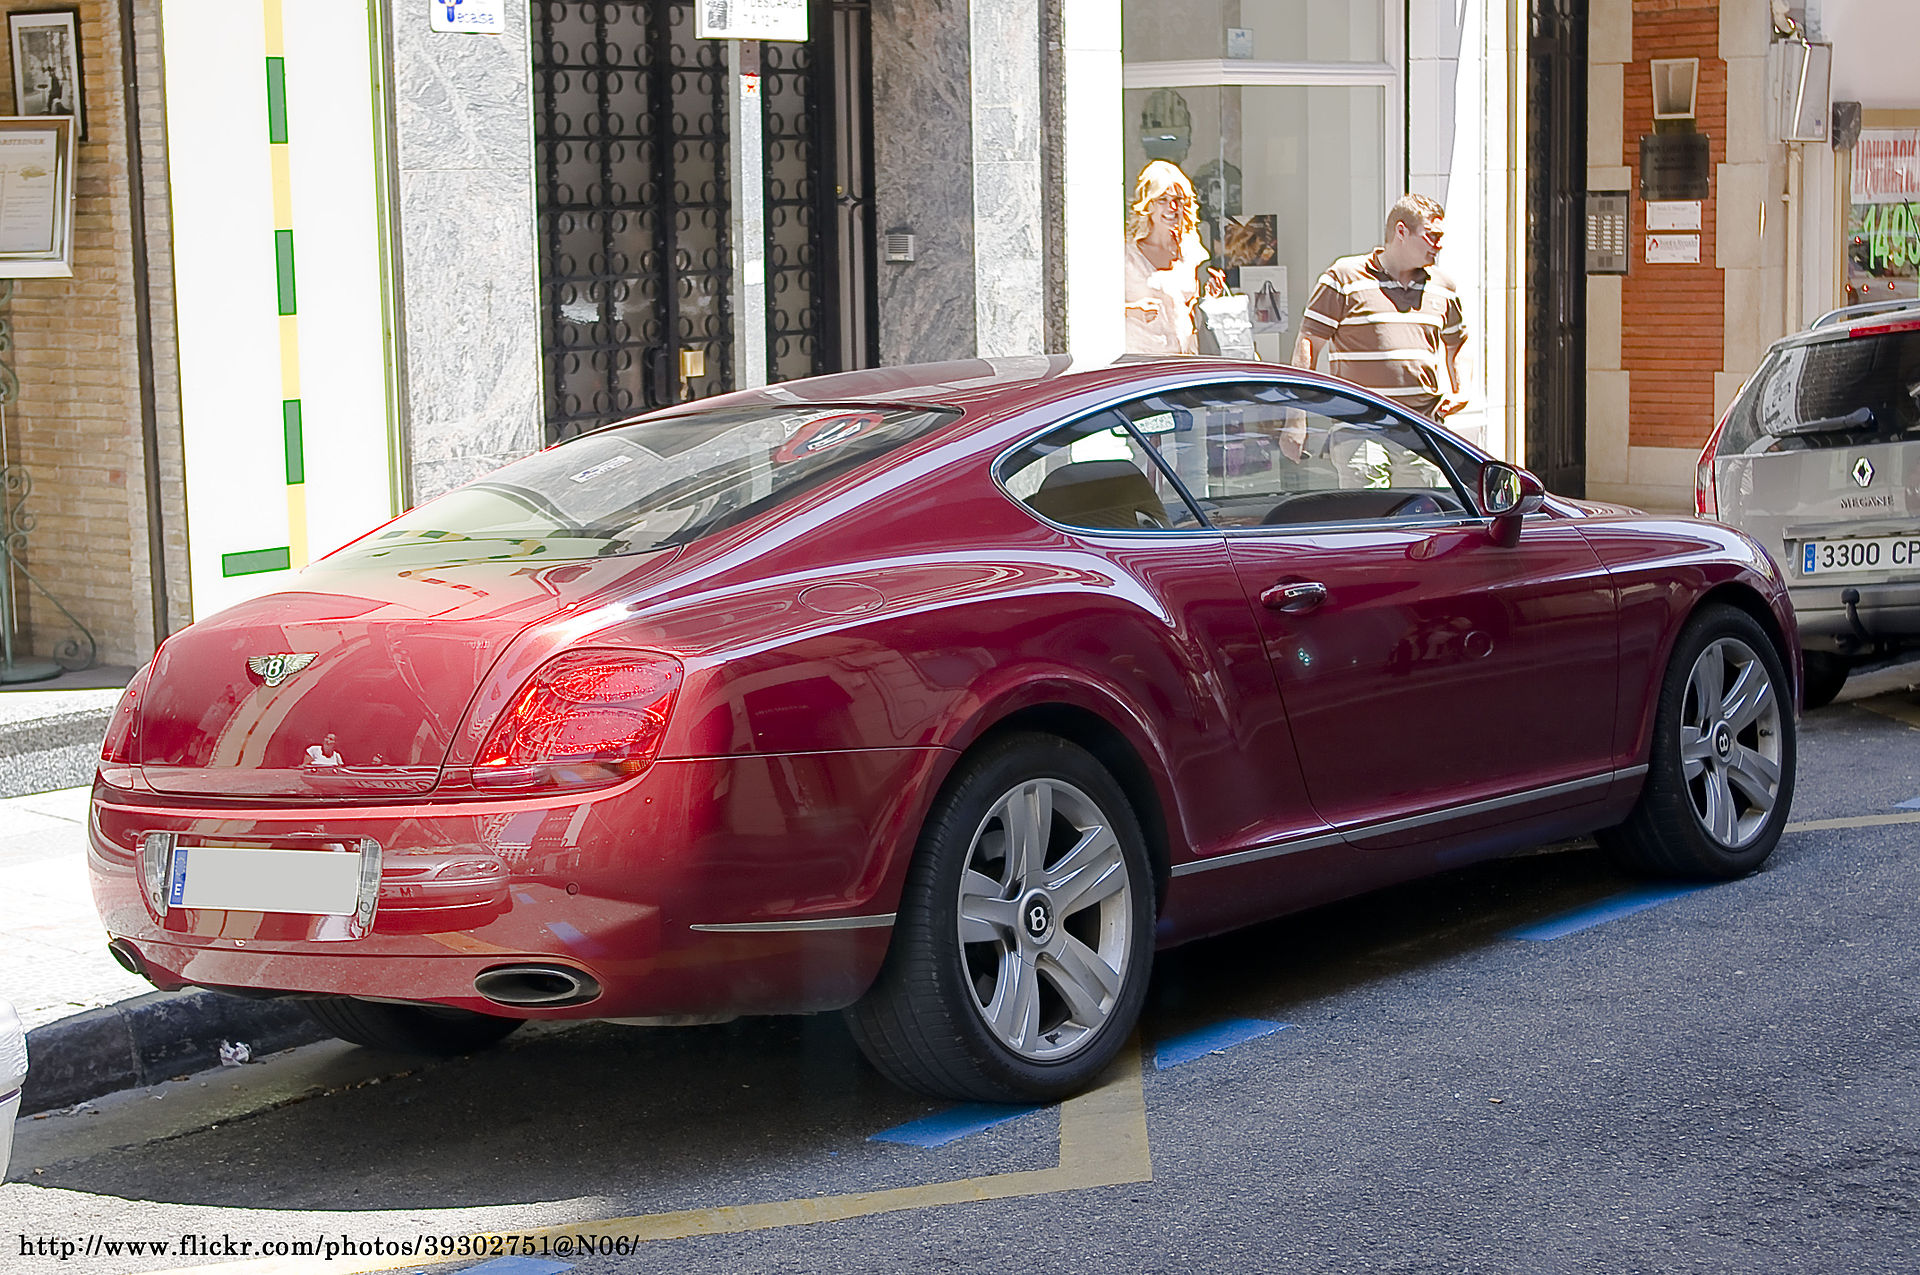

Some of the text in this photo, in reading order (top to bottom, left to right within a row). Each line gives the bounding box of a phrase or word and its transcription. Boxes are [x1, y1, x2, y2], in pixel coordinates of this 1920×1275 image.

[1855, 128, 1920, 170] LIQUIDACIÓ
[1840, 495, 1894, 509] MEGANE
[1822, 540, 1920, 568] 3300 CP
[174, 883, 182, 896] E
[1030, 906, 1047, 931] B
